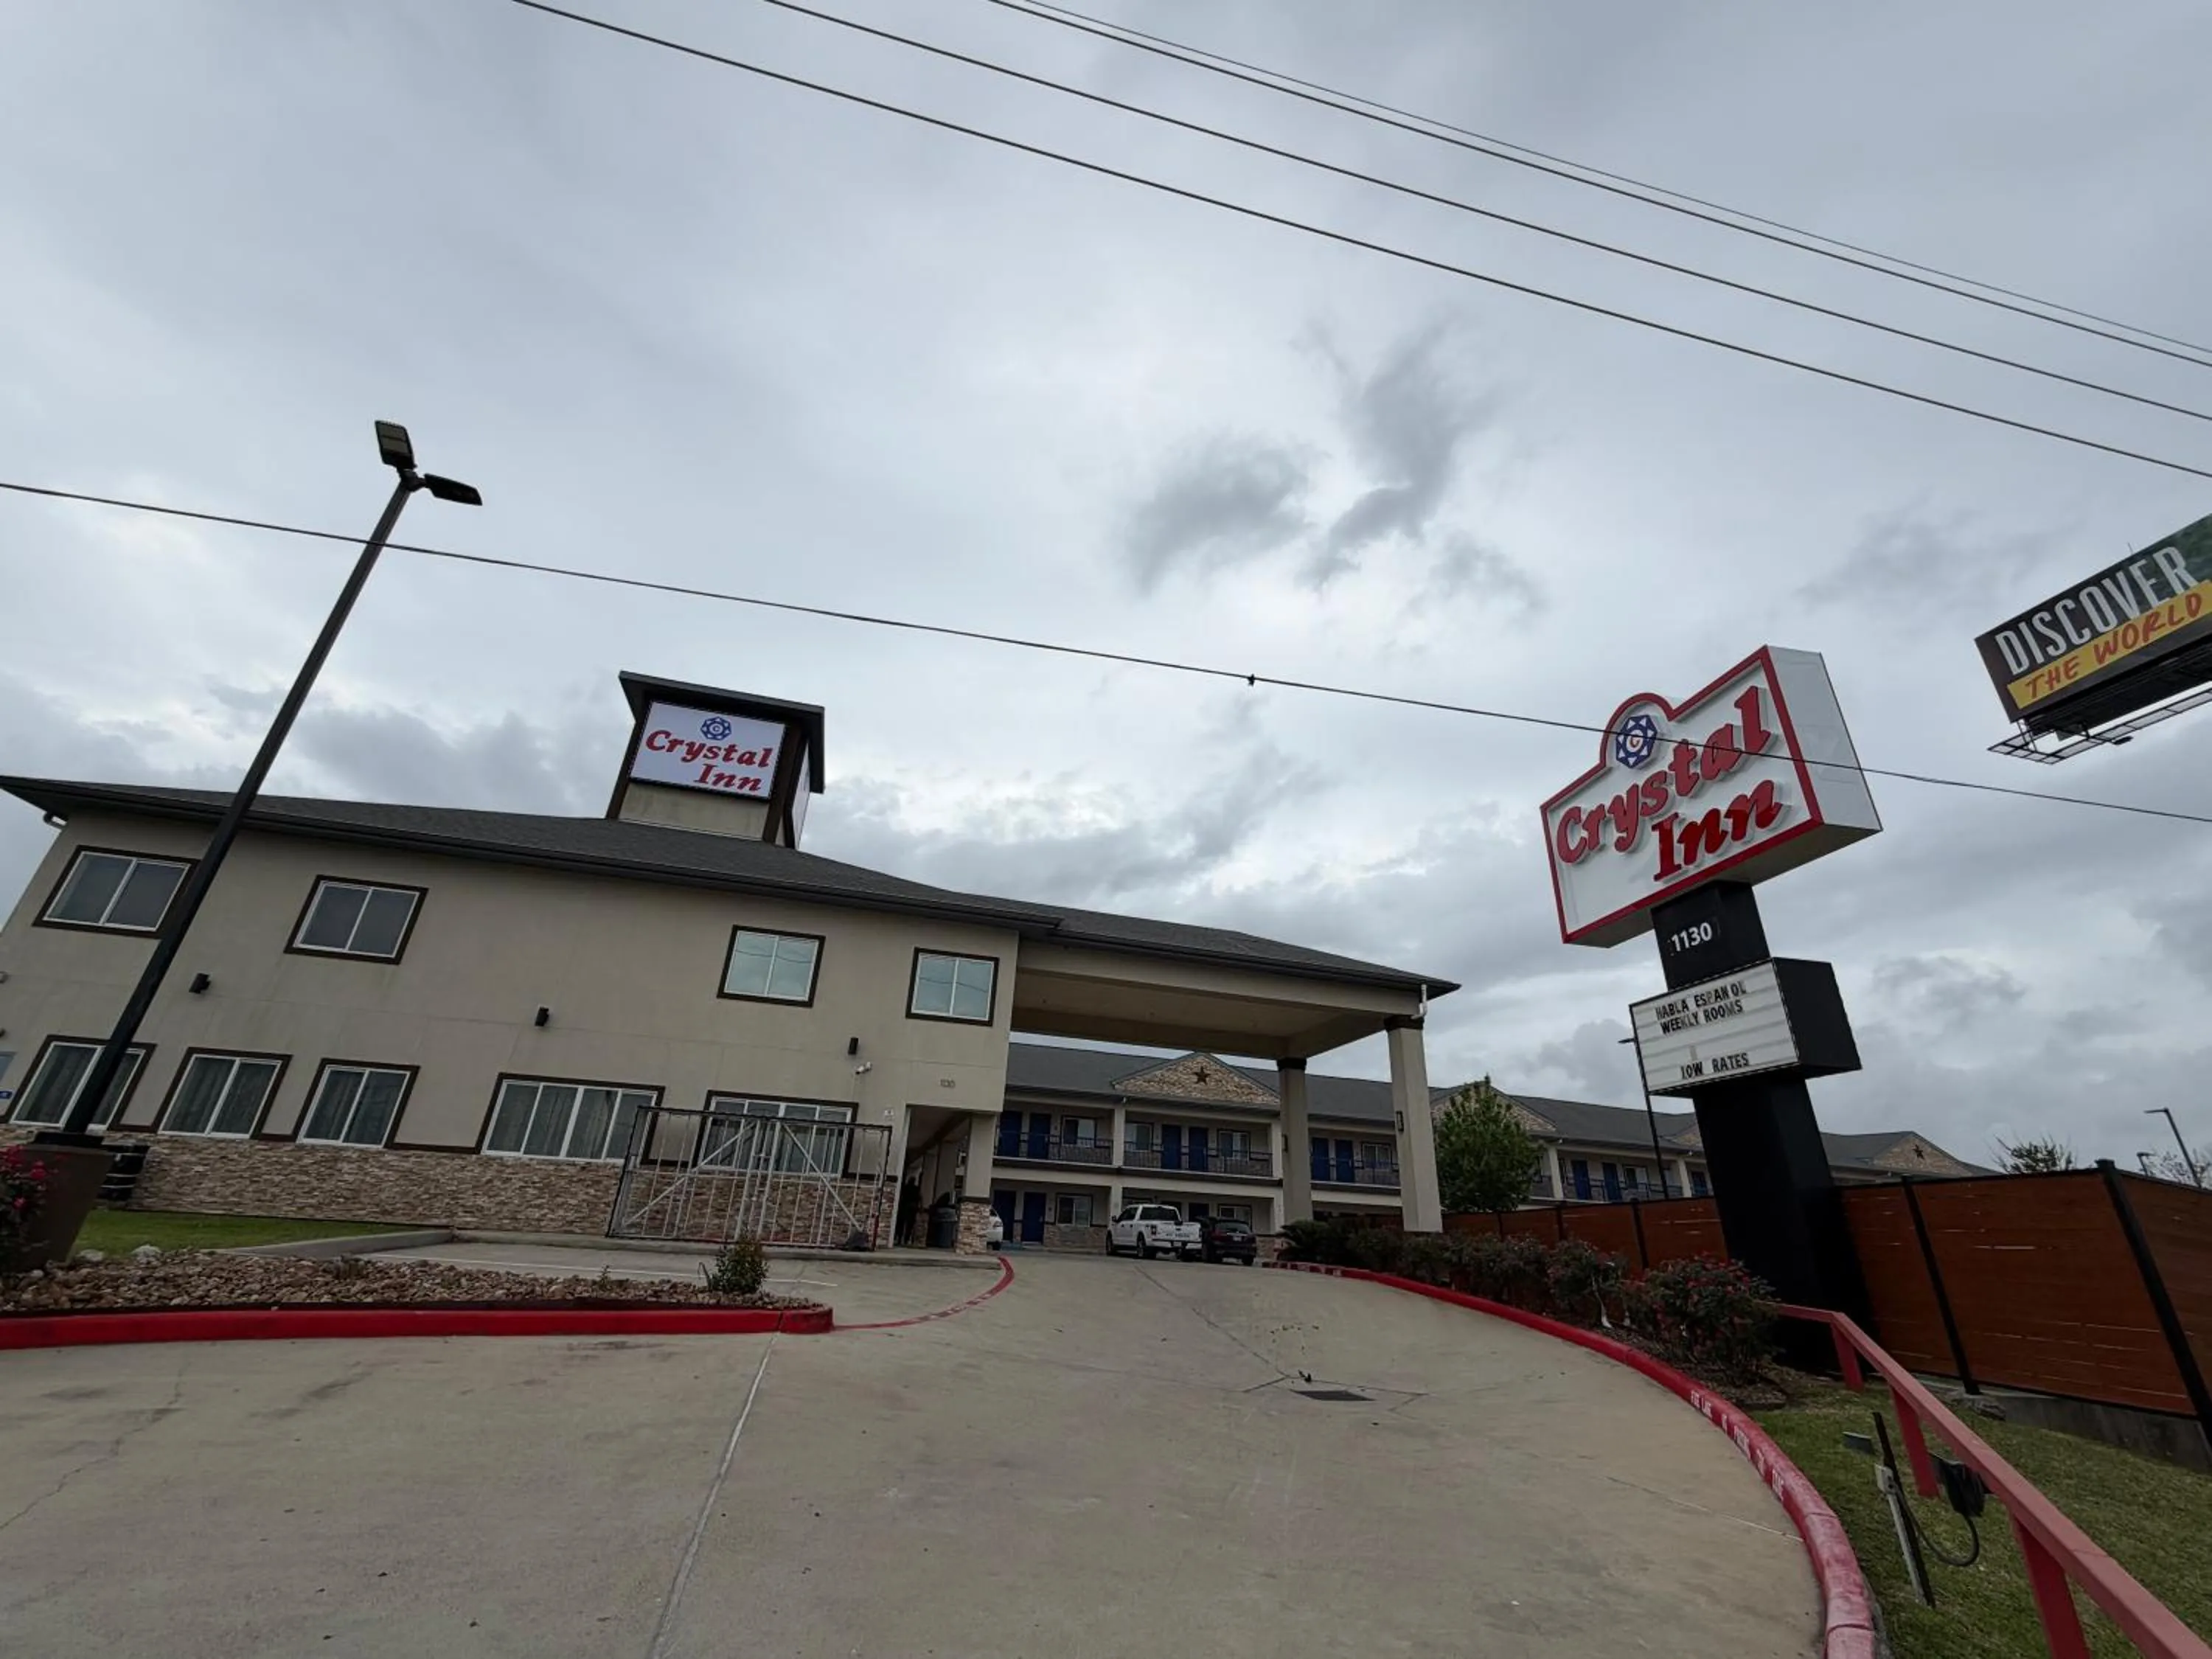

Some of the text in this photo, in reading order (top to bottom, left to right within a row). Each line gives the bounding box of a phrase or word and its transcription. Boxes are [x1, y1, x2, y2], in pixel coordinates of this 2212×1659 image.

[1994, 546, 2199, 675] DISCOVER
[2025, 592, 2202, 700] THE WORLD
[644, 729, 773, 768] Crystal
[694, 763, 762, 792] Inn
[1557, 685, 1771, 864] Crystal
[1651, 779, 1783, 882] Inn
[1671, 922, 1712, 952] 1130
[1655, 999, 1689, 1021] HABLA
[1660, 999, 1743, 1034] WEEKLY ROOMS
[1711, 1052, 1750, 1074] RATES
